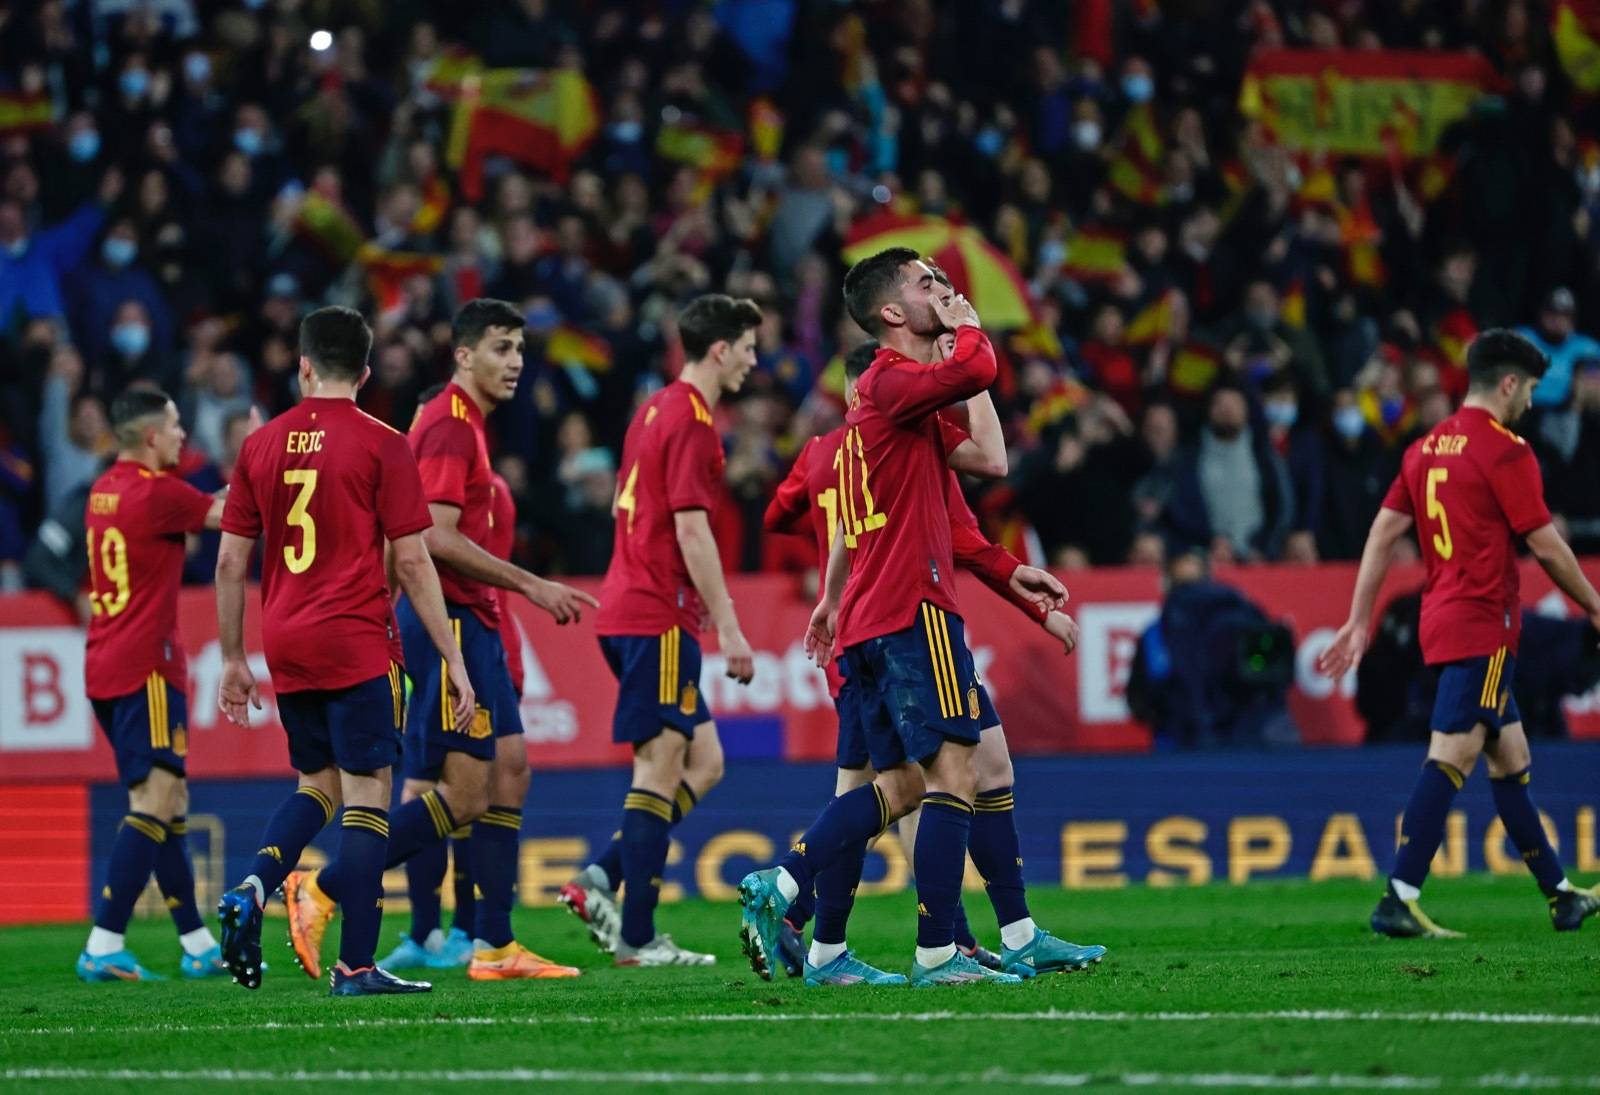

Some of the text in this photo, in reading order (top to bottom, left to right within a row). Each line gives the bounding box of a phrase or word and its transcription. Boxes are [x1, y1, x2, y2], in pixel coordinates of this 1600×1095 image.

[286, 430, 326, 454] ERIC
[283, 469, 318, 575] 3
[616, 459, 640, 535] 4
[1426, 467, 1453, 561] 5
[86, 526, 131, 617] 19
[23, 652, 65, 727] B
